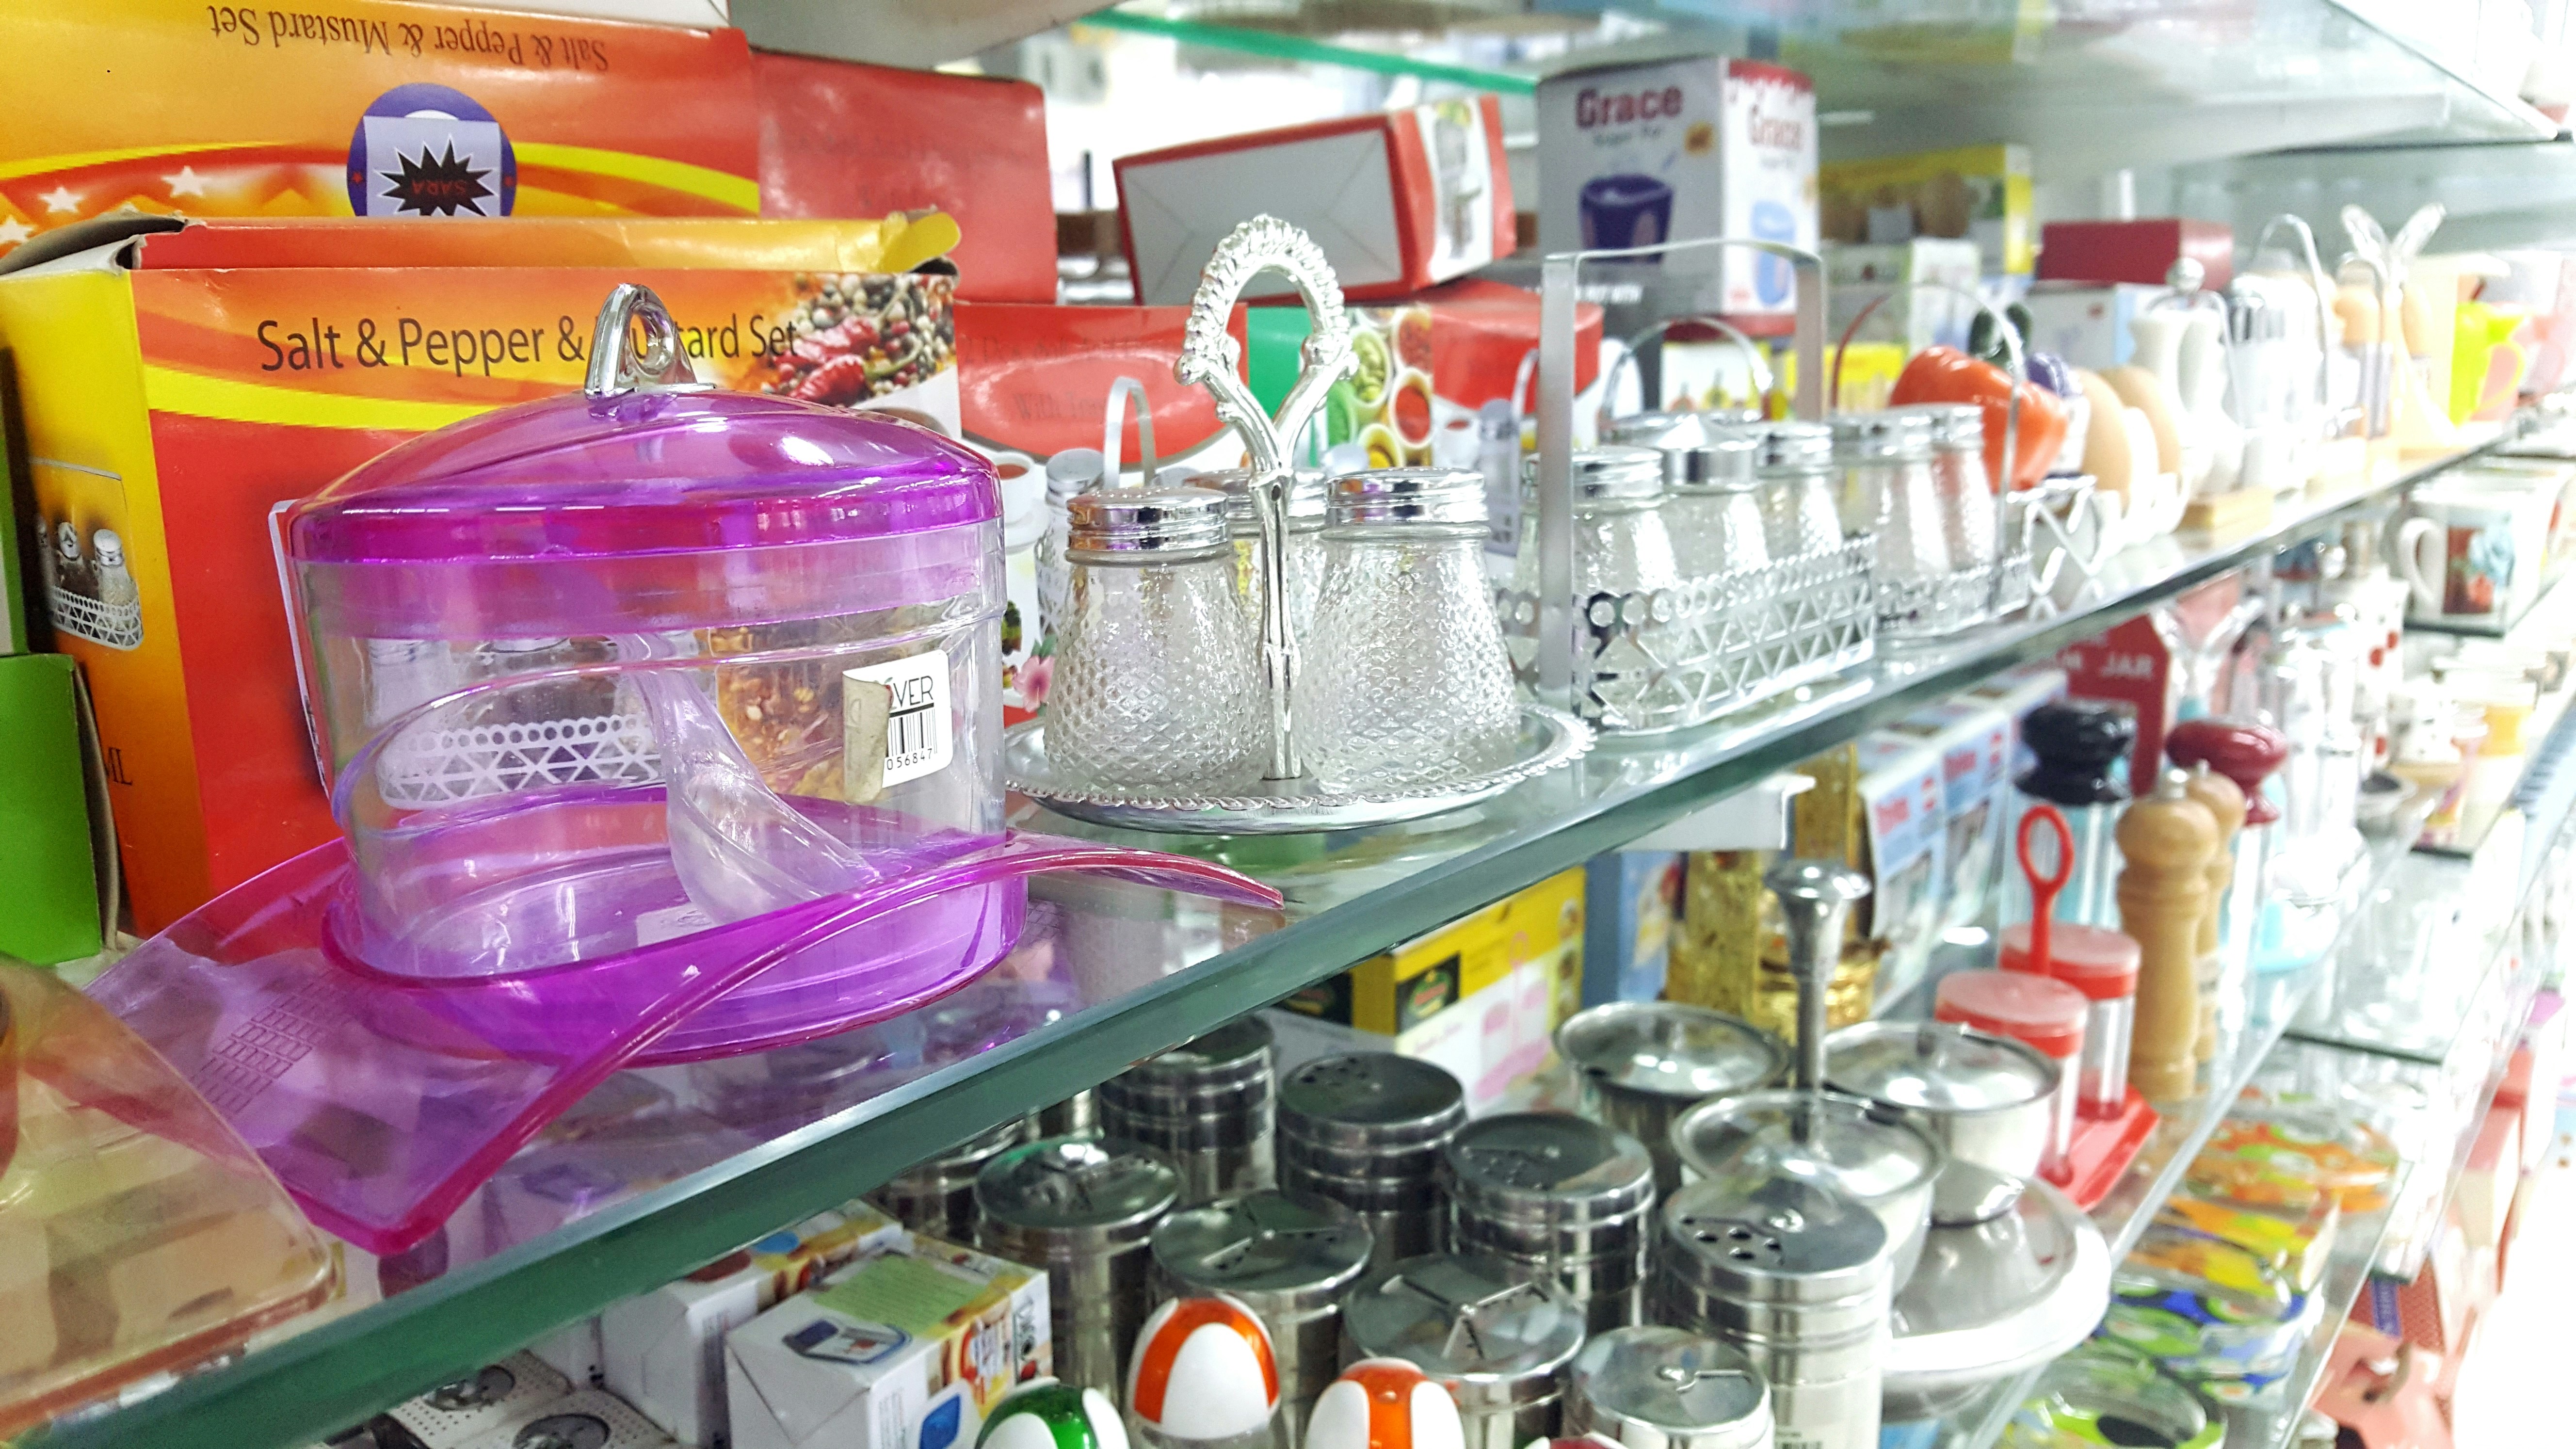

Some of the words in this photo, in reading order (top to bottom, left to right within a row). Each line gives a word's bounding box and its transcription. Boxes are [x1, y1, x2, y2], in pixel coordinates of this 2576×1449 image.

[206, 5, 261, 47] Set
[267, 10, 392, 56] Mustard
[398, 22, 424, 58] &
[434, 18, 524, 65] Pepper
[530, 34, 555, 67] &
[559, 36, 609, 71] Salt
[1576, 85, 1684, 130] Grace
[412, 180, 467, 195] SARA
[257, 317, 344, 371] Salt
[356, 317, 389, 368] &
[398, 317, 545, 378] Pepper
[557, 314, 586, 362] &
[749, 314, 799, 357] Set
[890, 675, 934, 708] VER
